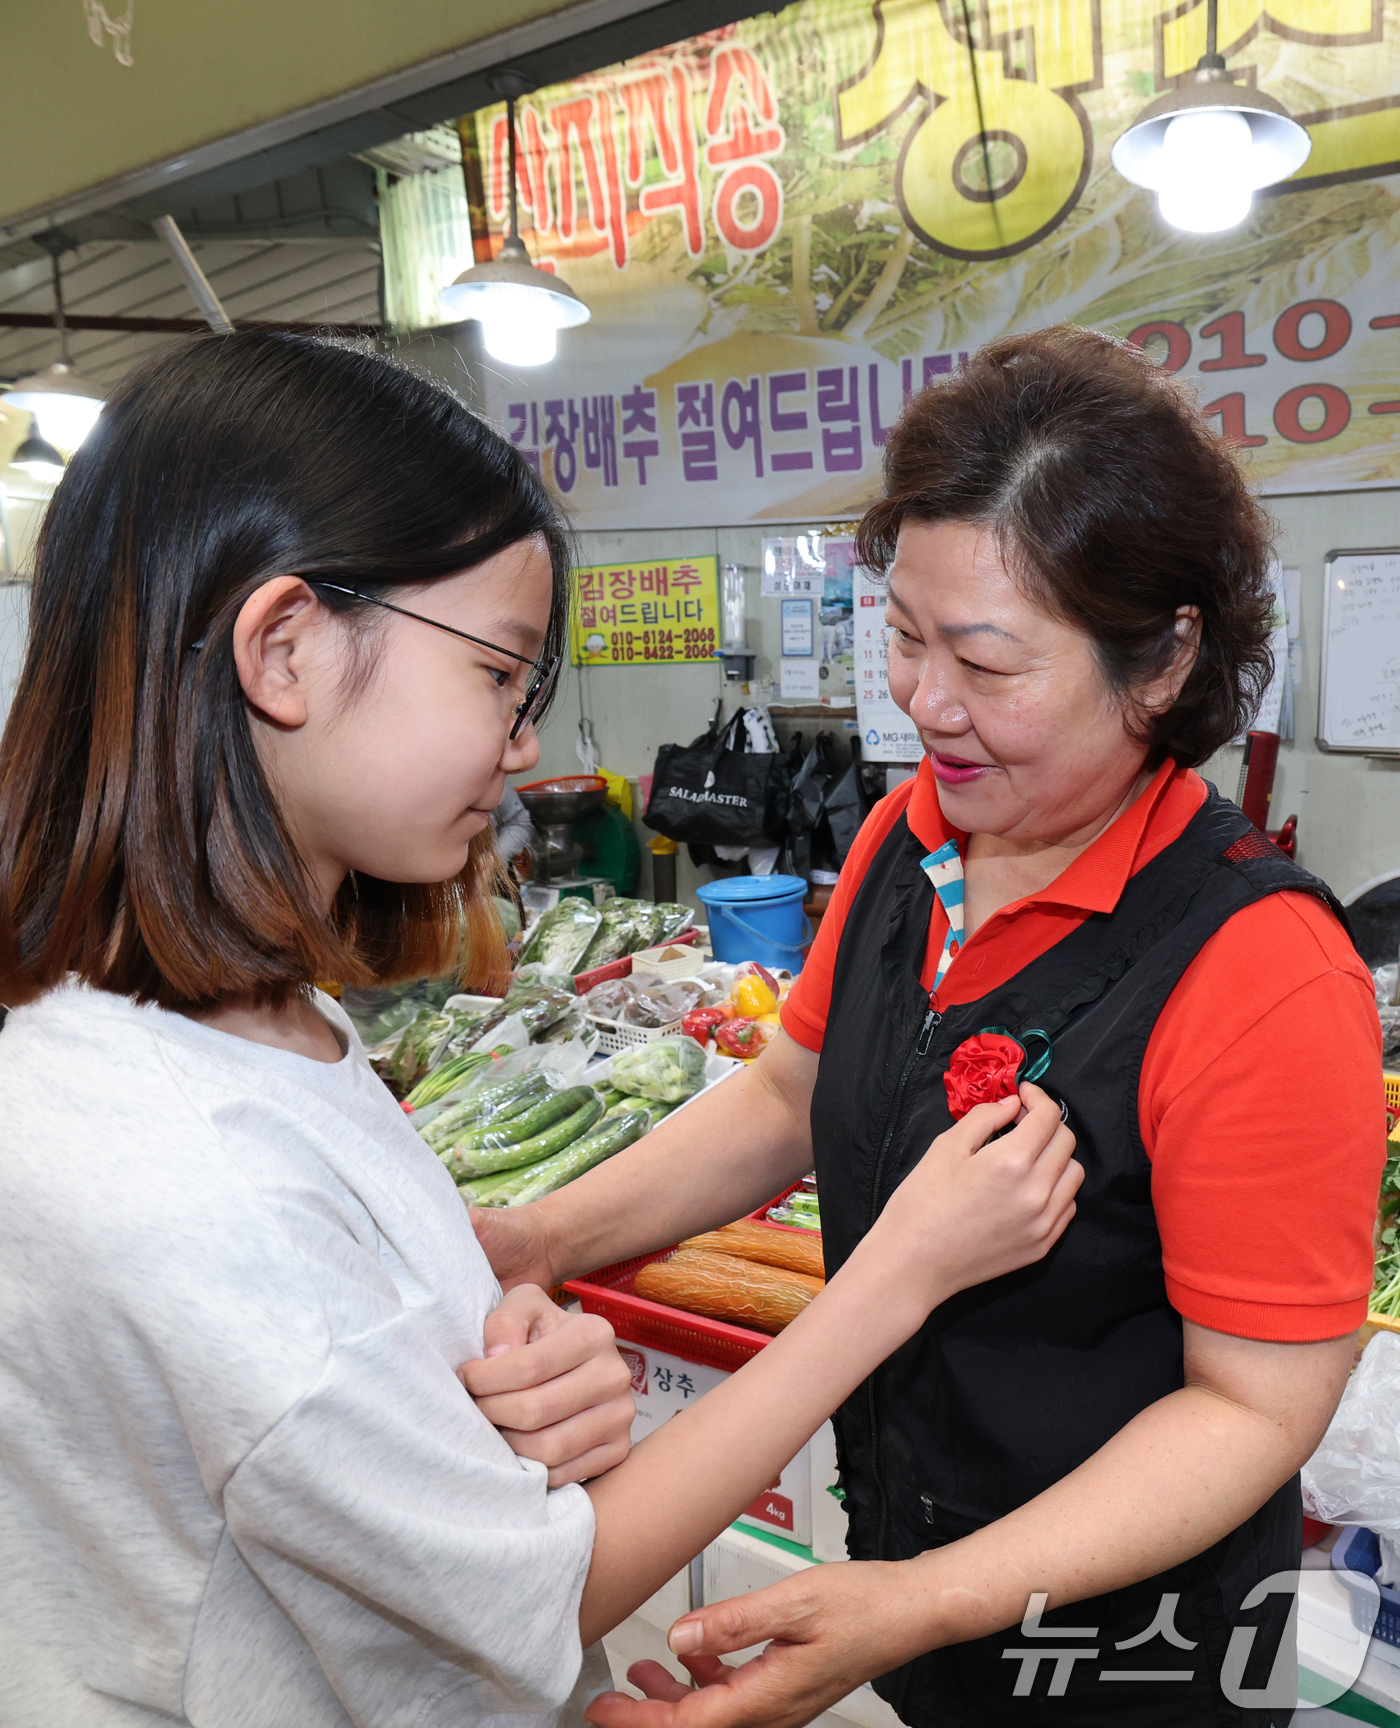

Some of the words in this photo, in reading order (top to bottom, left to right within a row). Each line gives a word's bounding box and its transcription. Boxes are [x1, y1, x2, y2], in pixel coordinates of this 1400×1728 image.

[508, 384, 659, 493] 김장배추
[579, 565, 703, 602] 김장배추
[580, 599, 703, 628] 절여드립니다
[865, 630, 871, 638] 4
[864, 650, 873, 659] 11
[864, 670, 873, 679] 18
[879, 670, 888, 679] 19
[863, 690, 873, 699] 25
[878, 690, 888, 699] 26
[882, 732, 899, 742] MG
[653, 1366, 696, 1399] 상추
[765, 1501, 786, 1521] 4kg
